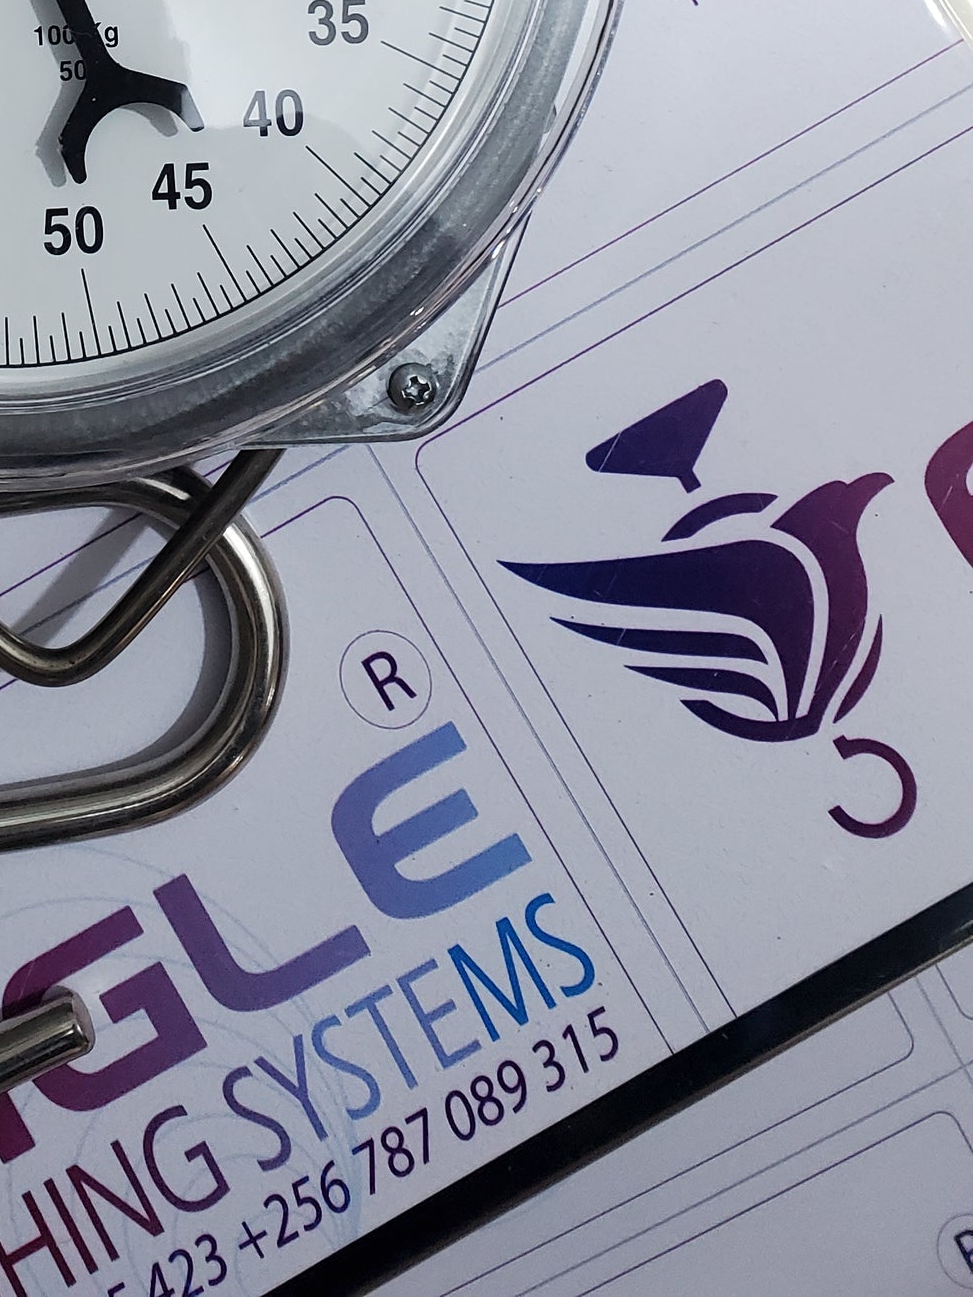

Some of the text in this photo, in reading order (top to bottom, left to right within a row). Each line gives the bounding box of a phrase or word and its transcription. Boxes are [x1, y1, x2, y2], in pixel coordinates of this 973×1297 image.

[242, 89, 304, 137] 40
[151, 162, 213, 210] 45
[43, 206, 104, 255] 50
[221, 892, 595, 1172] SYSTEMS
[238, 1162, 351, 1262] +256
[353, 1108, 431, 1196] 787
[444, 1059, 529, 1142] 089
[532, 1006, 620, 1093] 315
